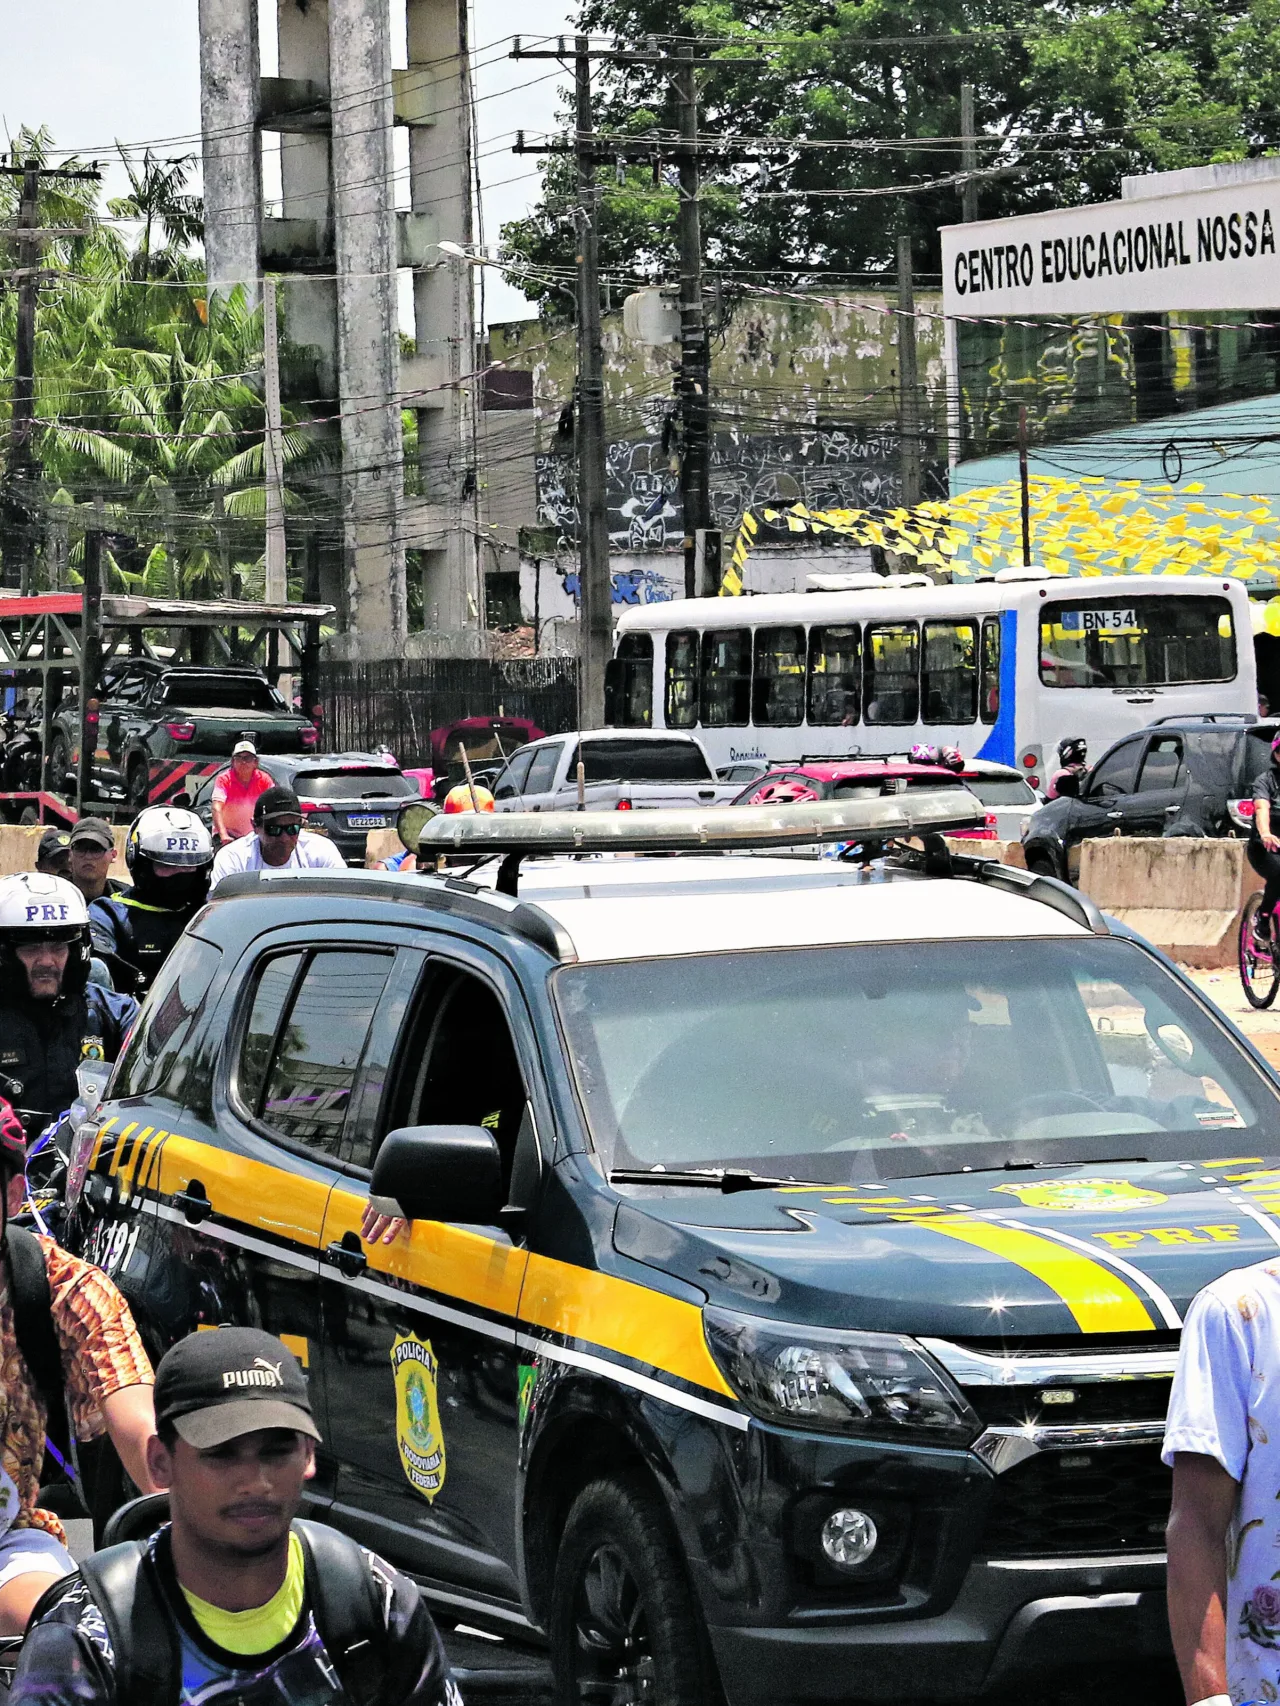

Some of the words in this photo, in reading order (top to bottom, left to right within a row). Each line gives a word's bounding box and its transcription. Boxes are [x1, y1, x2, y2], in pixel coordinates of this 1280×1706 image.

[954, 242, 1034, 296] CENTRO
[1041, 219, 1191, 285] EDUCACIONAL
[1197, 208, 1276, 263] NOSSA
[1083, 611, 1134, 629] BN-54
[167, 837, 200, 850] PRF
[25, 904, 69, 921] PRF
[1091, 1224, 1241, 1250] PRF
[223, 1370, 277, 1388] PUMA
[411, 1469, 439, 1488] FEDERAL
